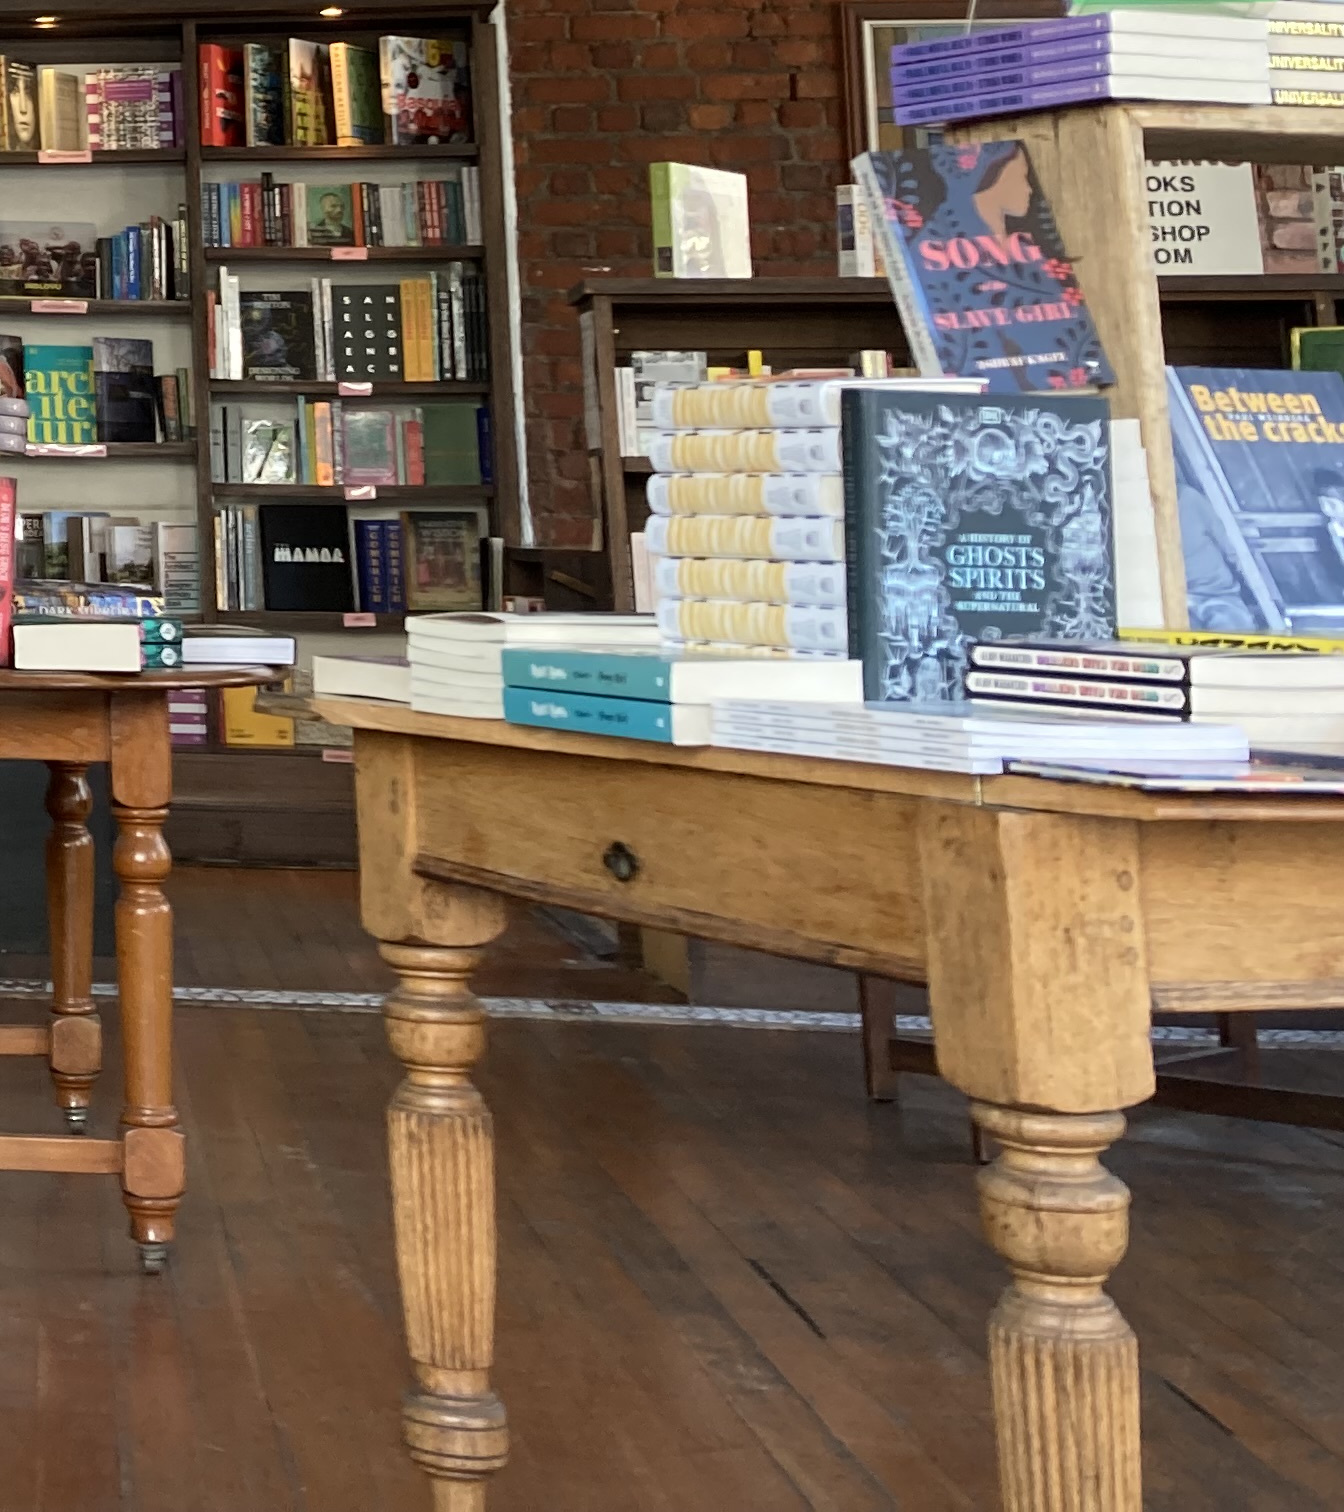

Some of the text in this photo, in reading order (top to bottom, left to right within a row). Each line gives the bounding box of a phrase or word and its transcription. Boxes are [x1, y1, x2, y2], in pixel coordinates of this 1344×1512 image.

[1146, 175, 1195, 193] OKS
[1148, 199, 1202, 217] TION
[919, 232, 1043, 272] SONG
[1154, 248, 1194, 265] OM
[932, 301, 1078, 330] SLAVE GIRL
[1190, 384, 1321, 416] Between
[1205, 416, 1260, 441] the
[970, 533, 1032, 544] HISTORY OF
[946, 546, 1045, 568] GHOSTS
[948, 569, 1046, 590] SPIRITS
[998, 591, 1022, 602] THE
[955, 602, 1041, 614] SUPERNATURAL
